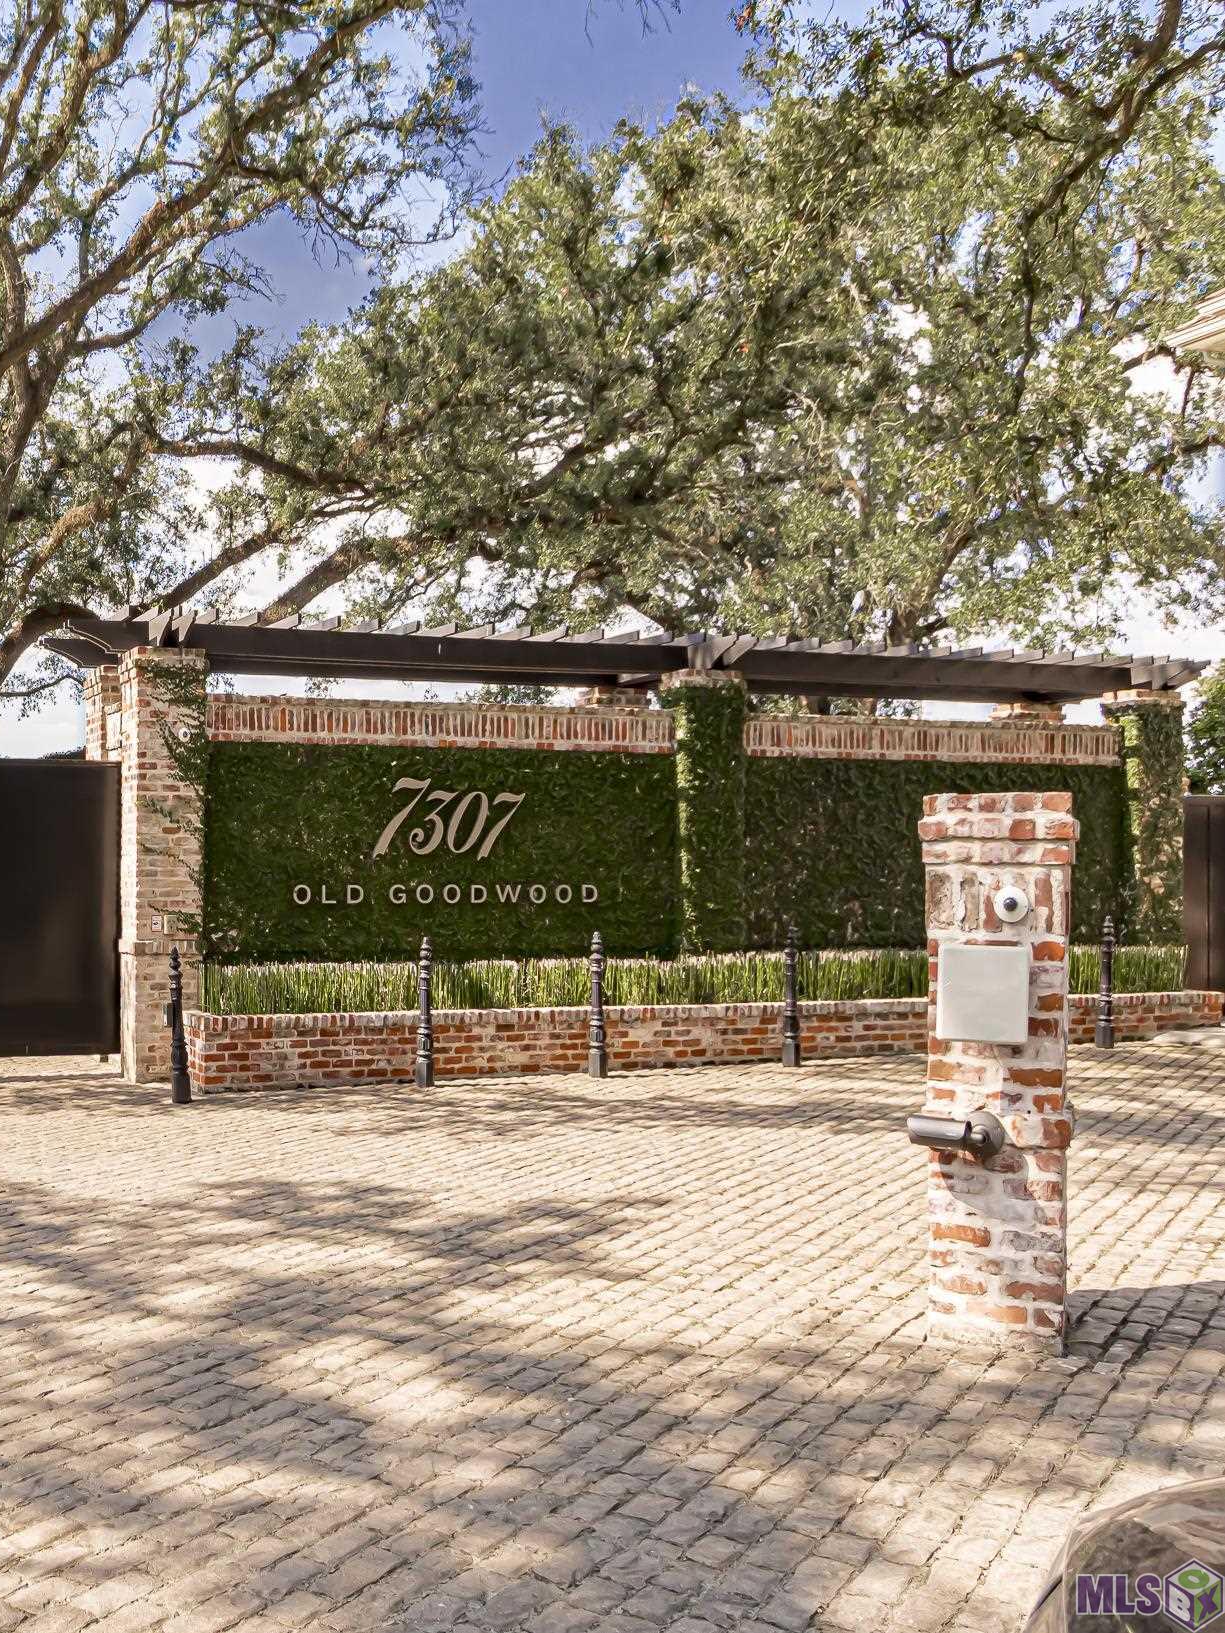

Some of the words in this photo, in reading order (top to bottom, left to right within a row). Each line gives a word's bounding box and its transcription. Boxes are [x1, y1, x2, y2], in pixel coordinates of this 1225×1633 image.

[373, 777, 526, 861] 7307
[292, 884, 364, 905] OLD
[388, 884, 600, 905] GOODWOOD
